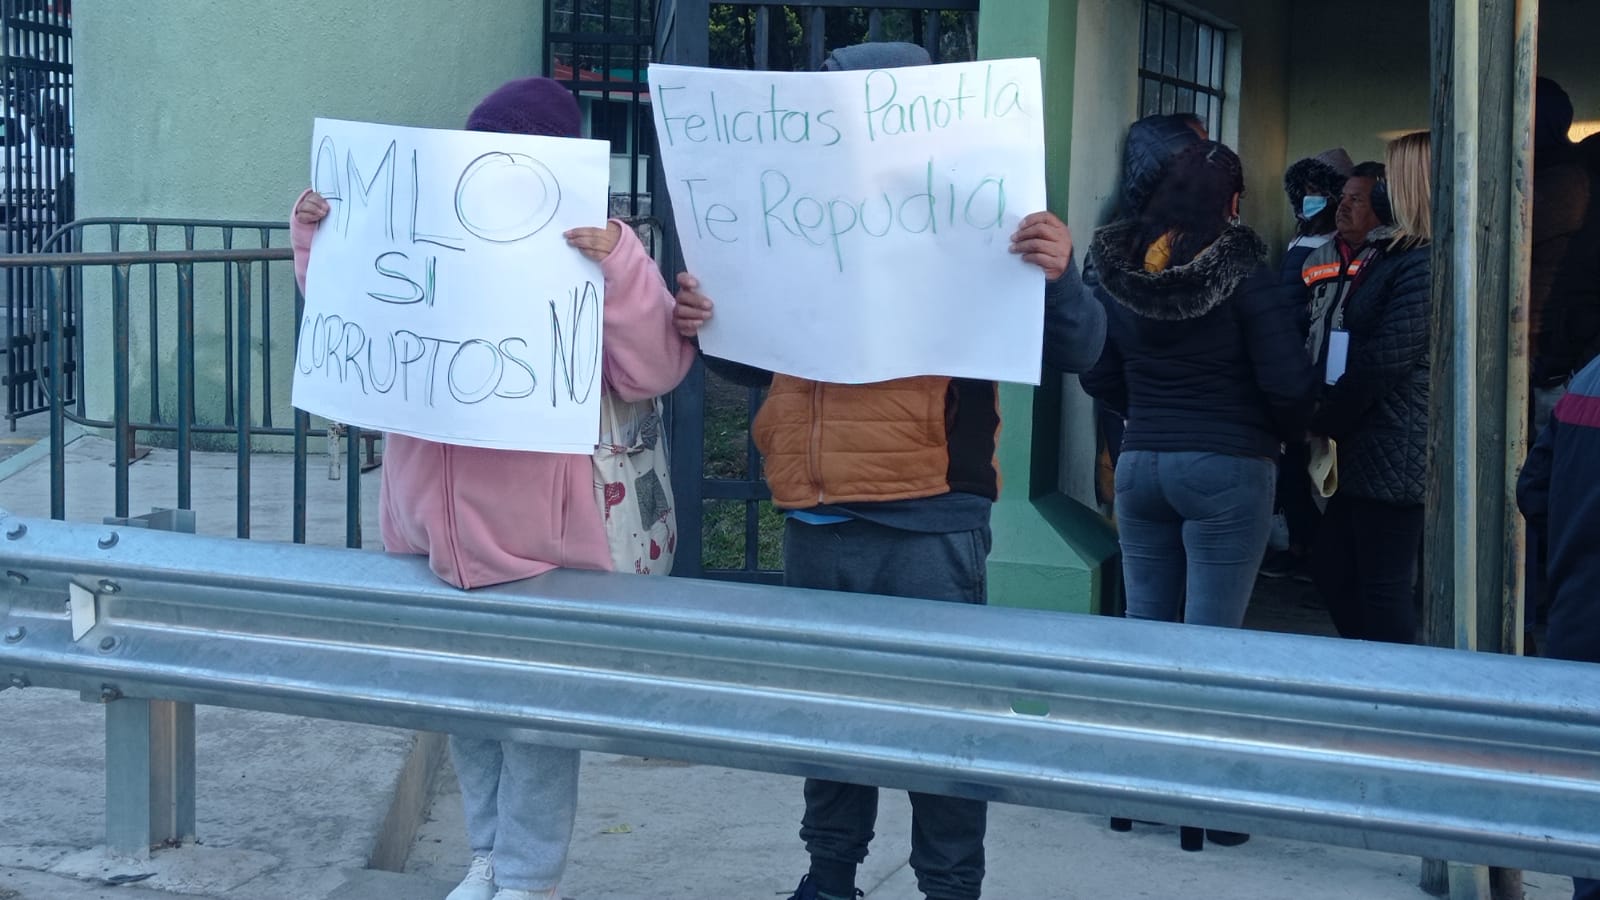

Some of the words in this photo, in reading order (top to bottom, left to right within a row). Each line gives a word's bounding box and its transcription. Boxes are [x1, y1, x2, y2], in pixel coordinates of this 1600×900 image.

[658, 84, 841, 146] Felicitas
[864, 65, 1022, 141] Panotla
[314, 135, 561, 252] AMLO
[681, 178, 738, 243] Te
[760, 160, 1007, 272] Repudia
[367, 251, 436, 307] SI
[298, 313, 537, 408] CORRUPTOS
[549, 281, 599, 408] NO
